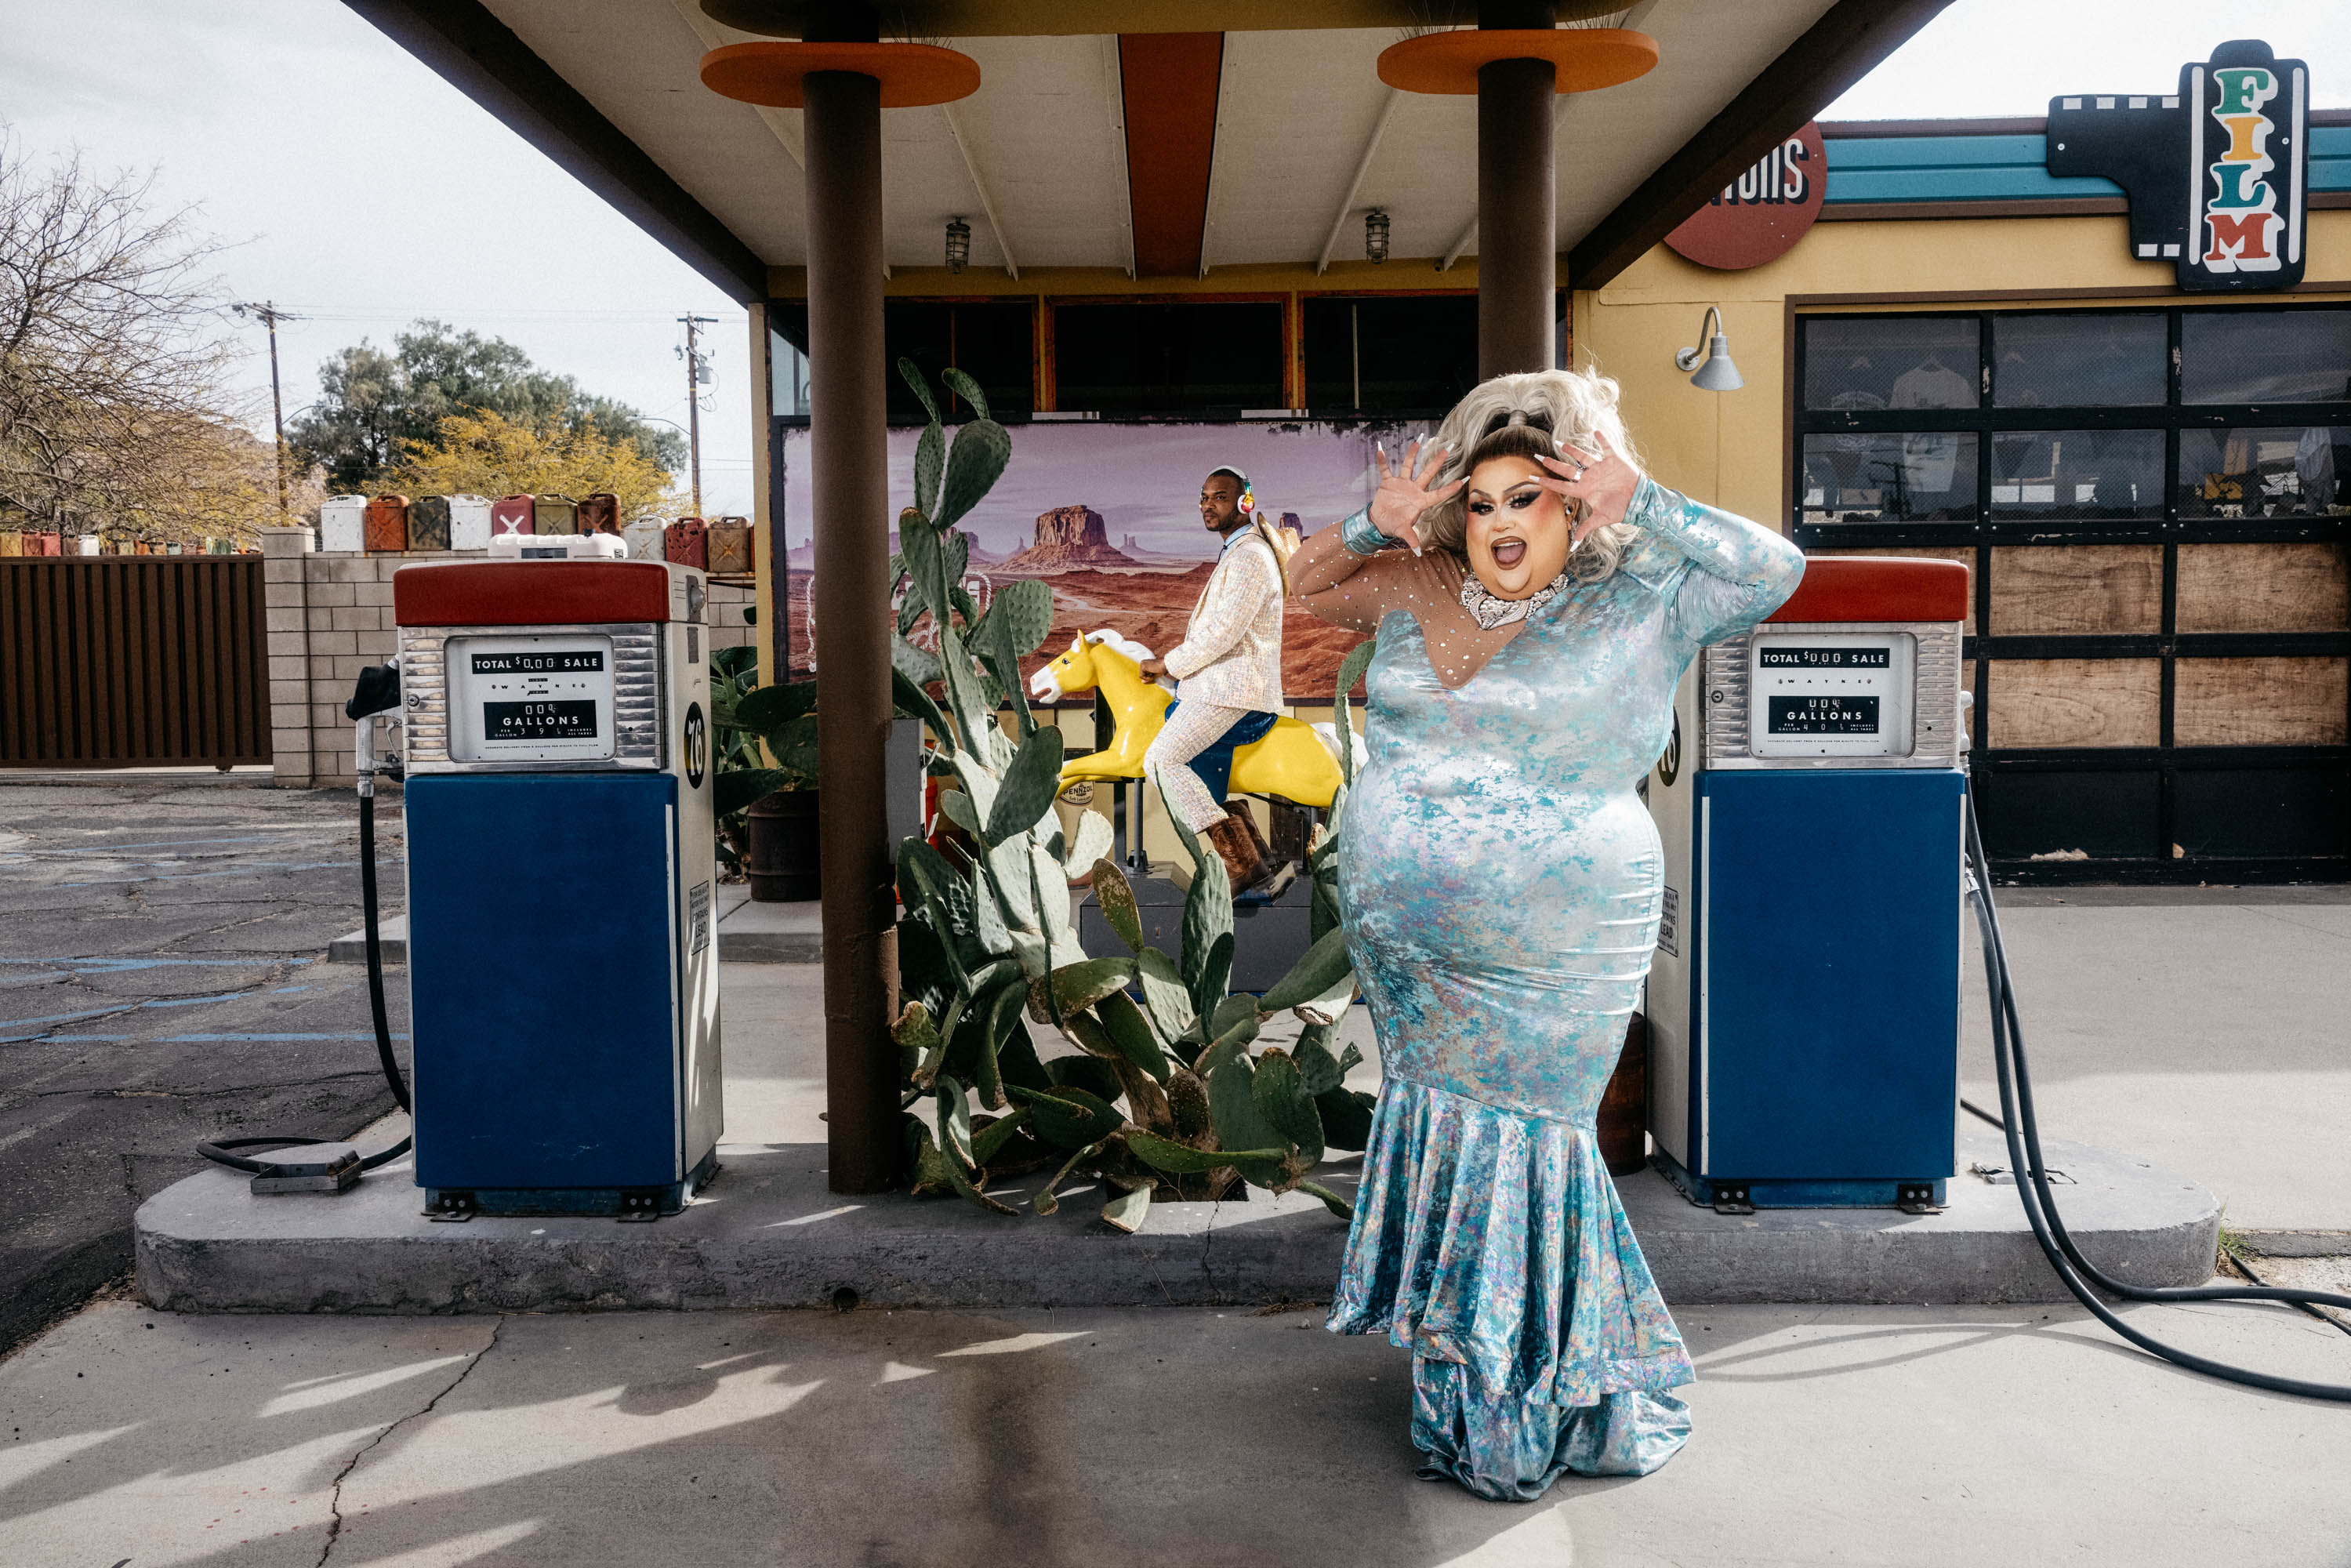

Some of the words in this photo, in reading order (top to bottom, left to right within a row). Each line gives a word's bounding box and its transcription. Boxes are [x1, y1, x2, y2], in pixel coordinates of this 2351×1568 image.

[2204, 67, 2282, 269] FILM
[475, 660, 512, 670] TOTAL
[564, 658, 598, 667] SALE
[1763, 654, 1800, 663] TOTAL
[1852, 654, 1885, 663] SALE
[502, 716, 579, 726] GALLONS
[1787, 711, 1863, 720] GALLONS
[688, 718, 703, 776] 76
[695, 921, 706, 938] LEAD
[1660, 922, 1673, 939] LEAD
